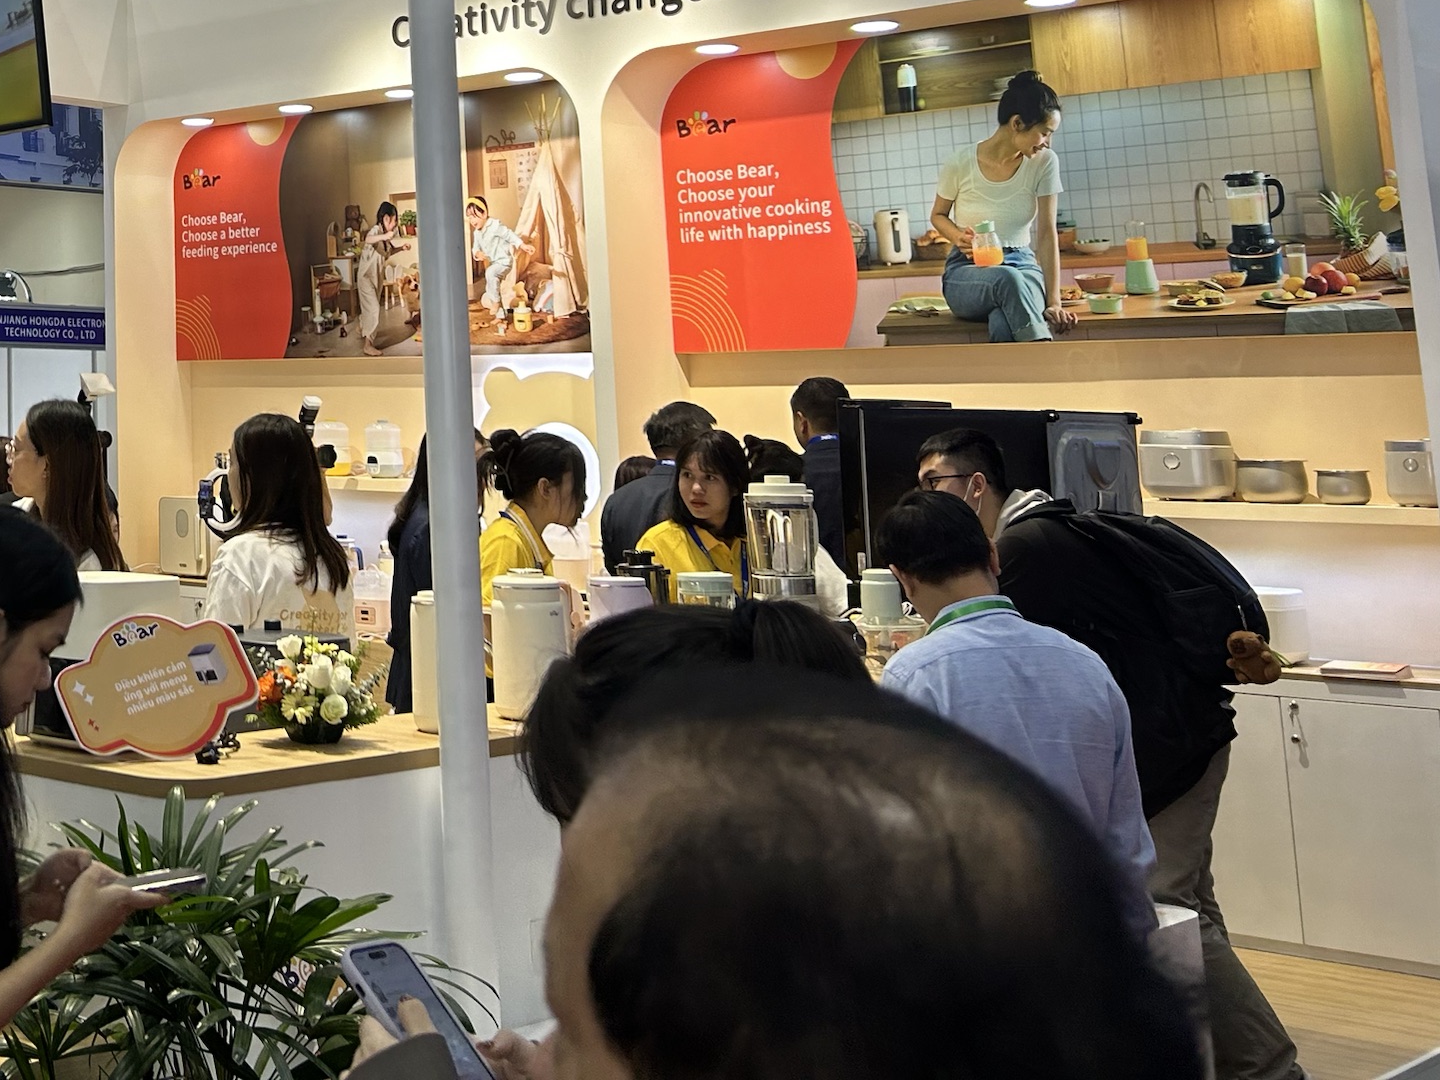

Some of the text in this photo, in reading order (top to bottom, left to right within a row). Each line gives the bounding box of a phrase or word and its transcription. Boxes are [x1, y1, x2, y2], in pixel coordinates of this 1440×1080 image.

[675, 111, 737, 138] Bear
[182, 168, 221, 190] Bear
[676, 164, 780, 185] Choose Bear,
[677, 184, 776, 204] Choose your
[181, 211, 247, 227] Choose Bear,
[679, 198, 832, 224] innovative cooking
[181, 226, 261, 243] Choose a better
[679, 220, 832, 244] life with happiness
[182, 241, 278, 260] feeding experience
[29, 316, 65, 327] HONGDA
[4, 327, 60, 338] TECHNOLOGY
[80, 330, 96, 339] LTD
[112, 622, 159, 648] Bear
[160, 674, 188, 689] menu
